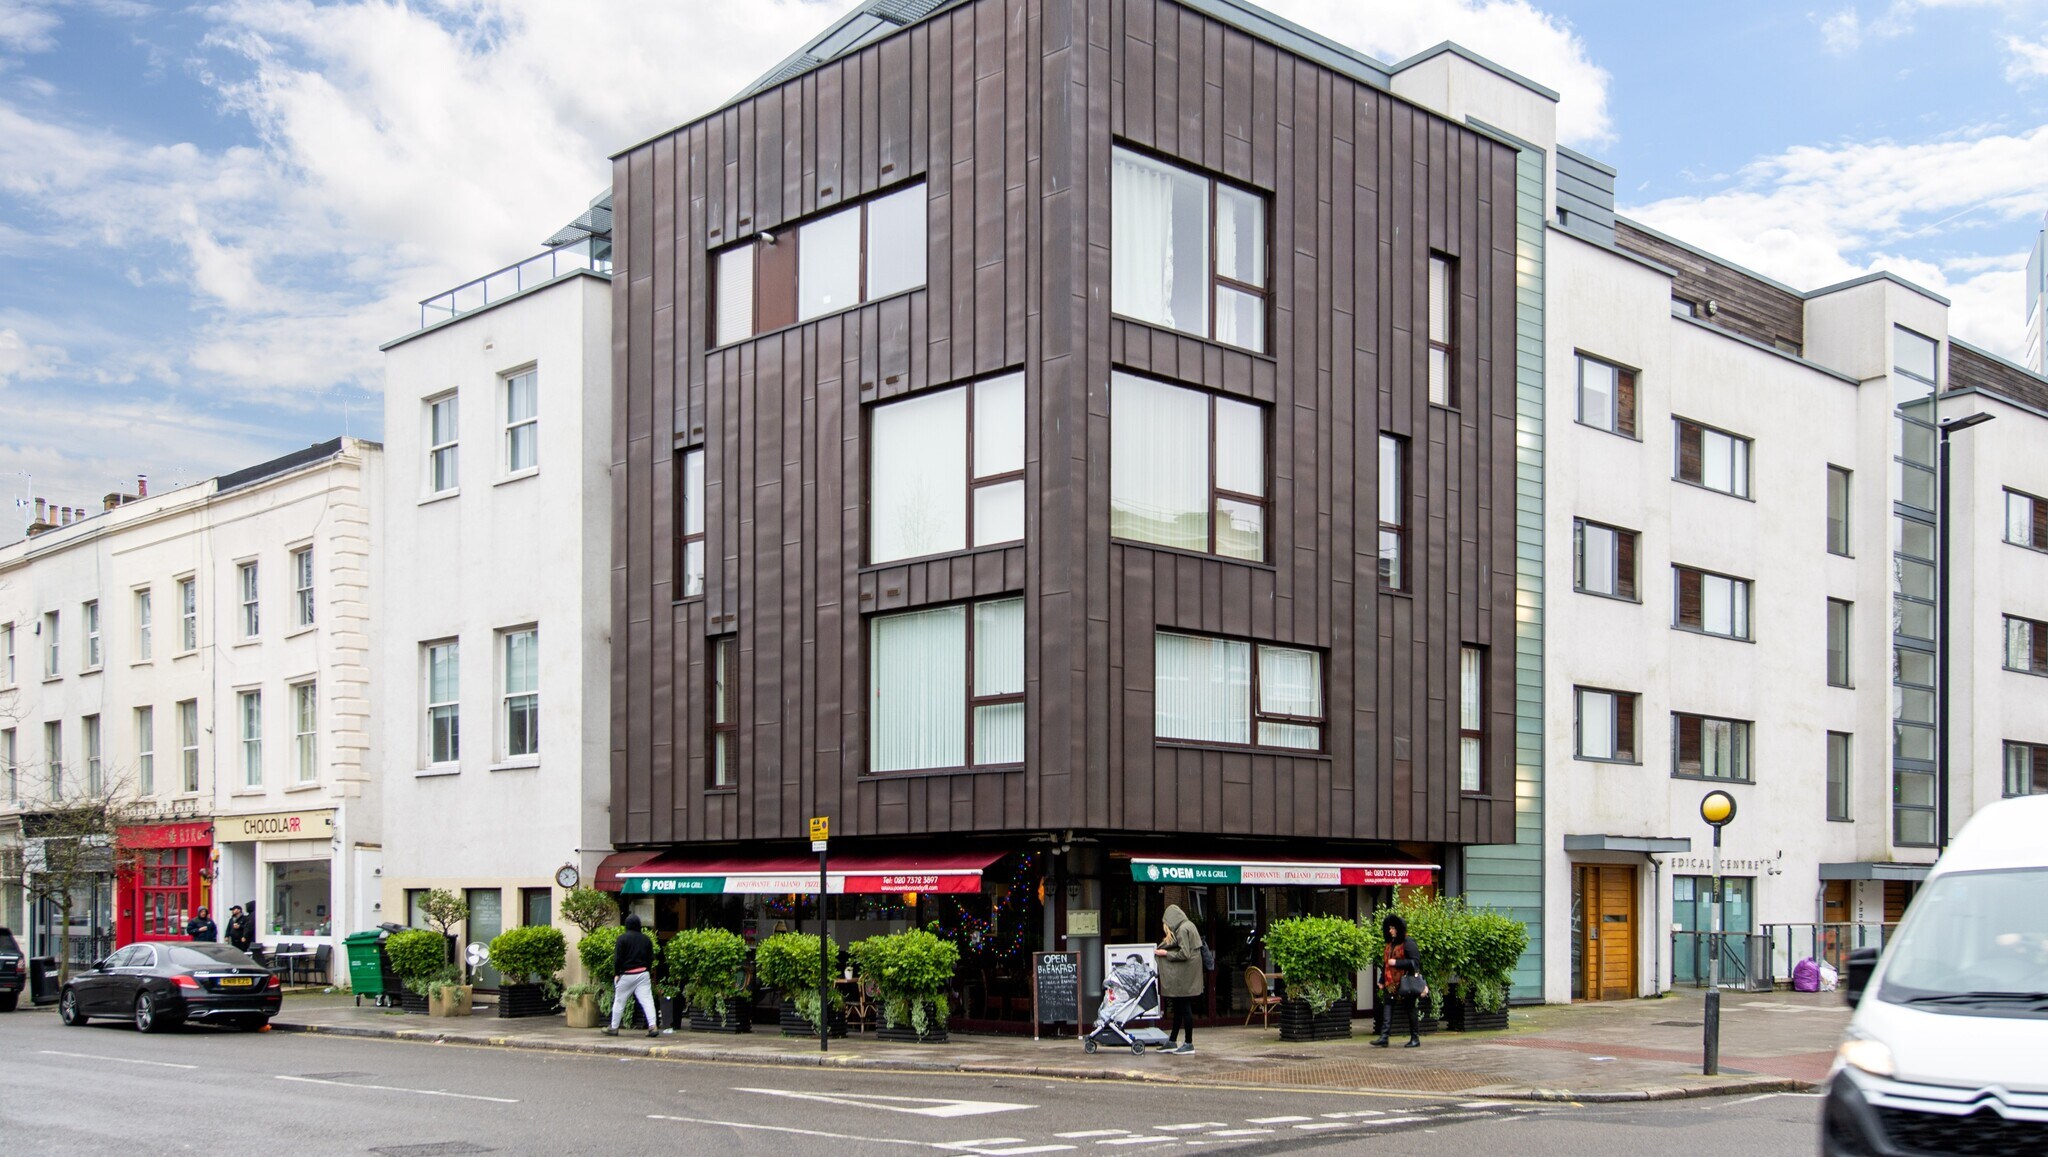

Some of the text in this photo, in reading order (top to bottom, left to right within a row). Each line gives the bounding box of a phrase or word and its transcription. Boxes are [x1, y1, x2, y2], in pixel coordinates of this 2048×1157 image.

[1720, 859, 1759, 870] CENTRE
[1162, 867, 1194, 879] POEM
[1213, 870, 1227, 878] GRILL
[652, 880, 676, 890] POEM
[923, 876, 938, 884] 3897
[1043, 954, 1068, 964] OPEN
[1038, 964, 1077, 974] BREAKFAST
